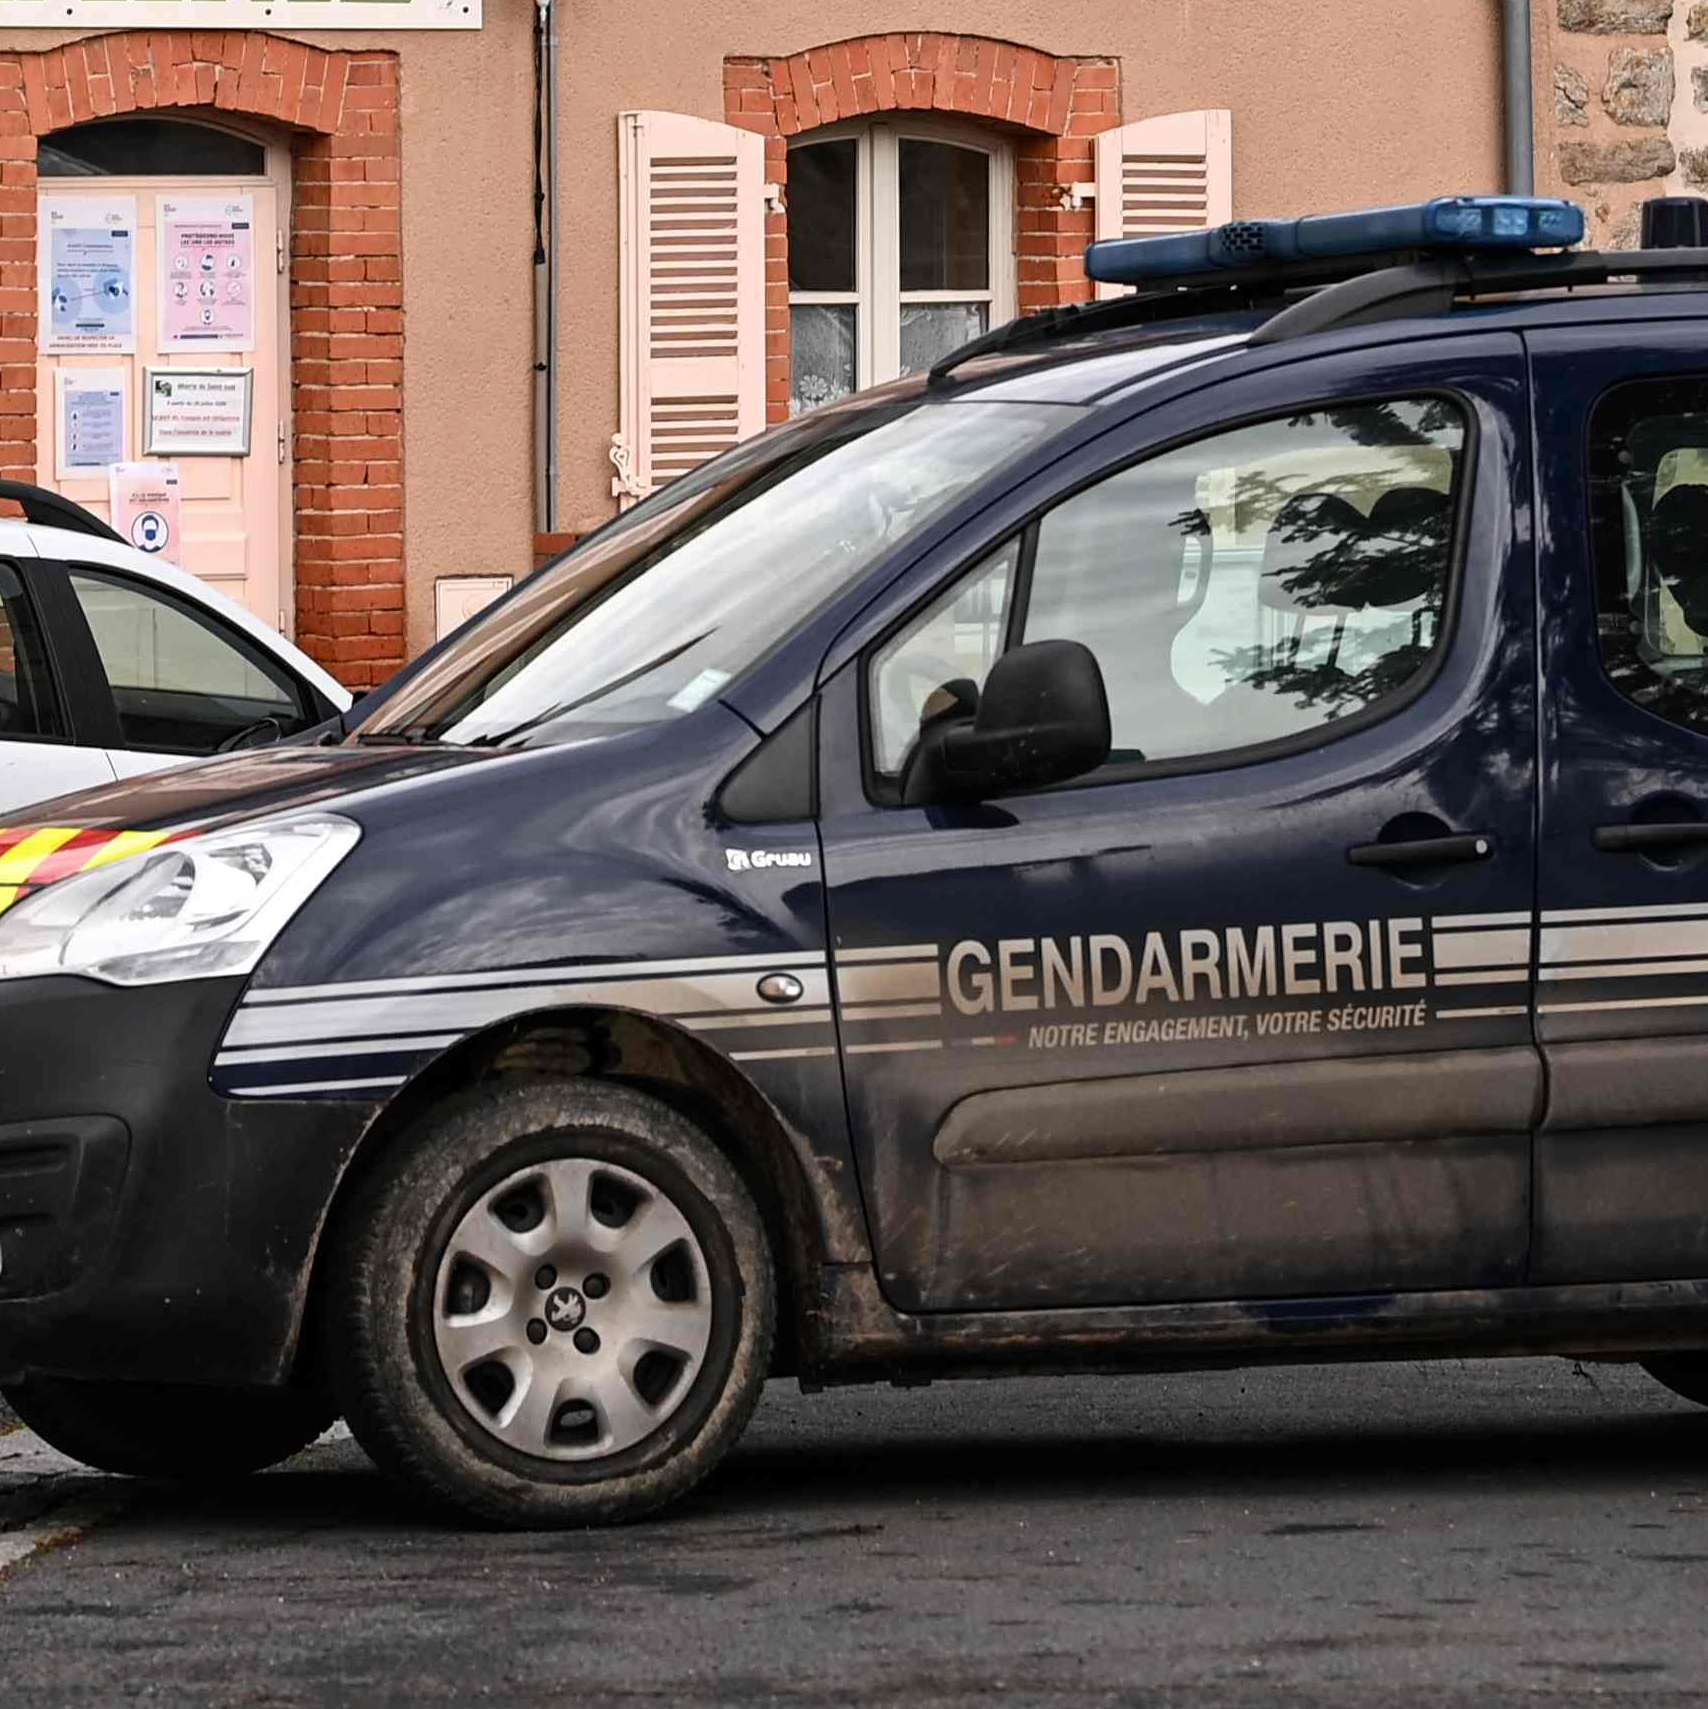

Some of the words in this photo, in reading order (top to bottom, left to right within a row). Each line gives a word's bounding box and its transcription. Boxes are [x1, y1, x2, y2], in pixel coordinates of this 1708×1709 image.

[947, 916, 1427, 1015] GENDARMERIE
[1028, 1022, 1099, 1050] NOTRE
[1103, 1014, 1251, 1045] ENGAGEMENT,
[1256, 1010, 1322, 1035] VOTRE
[1327, 998, 1428, 1031] SÉCURITÉ
